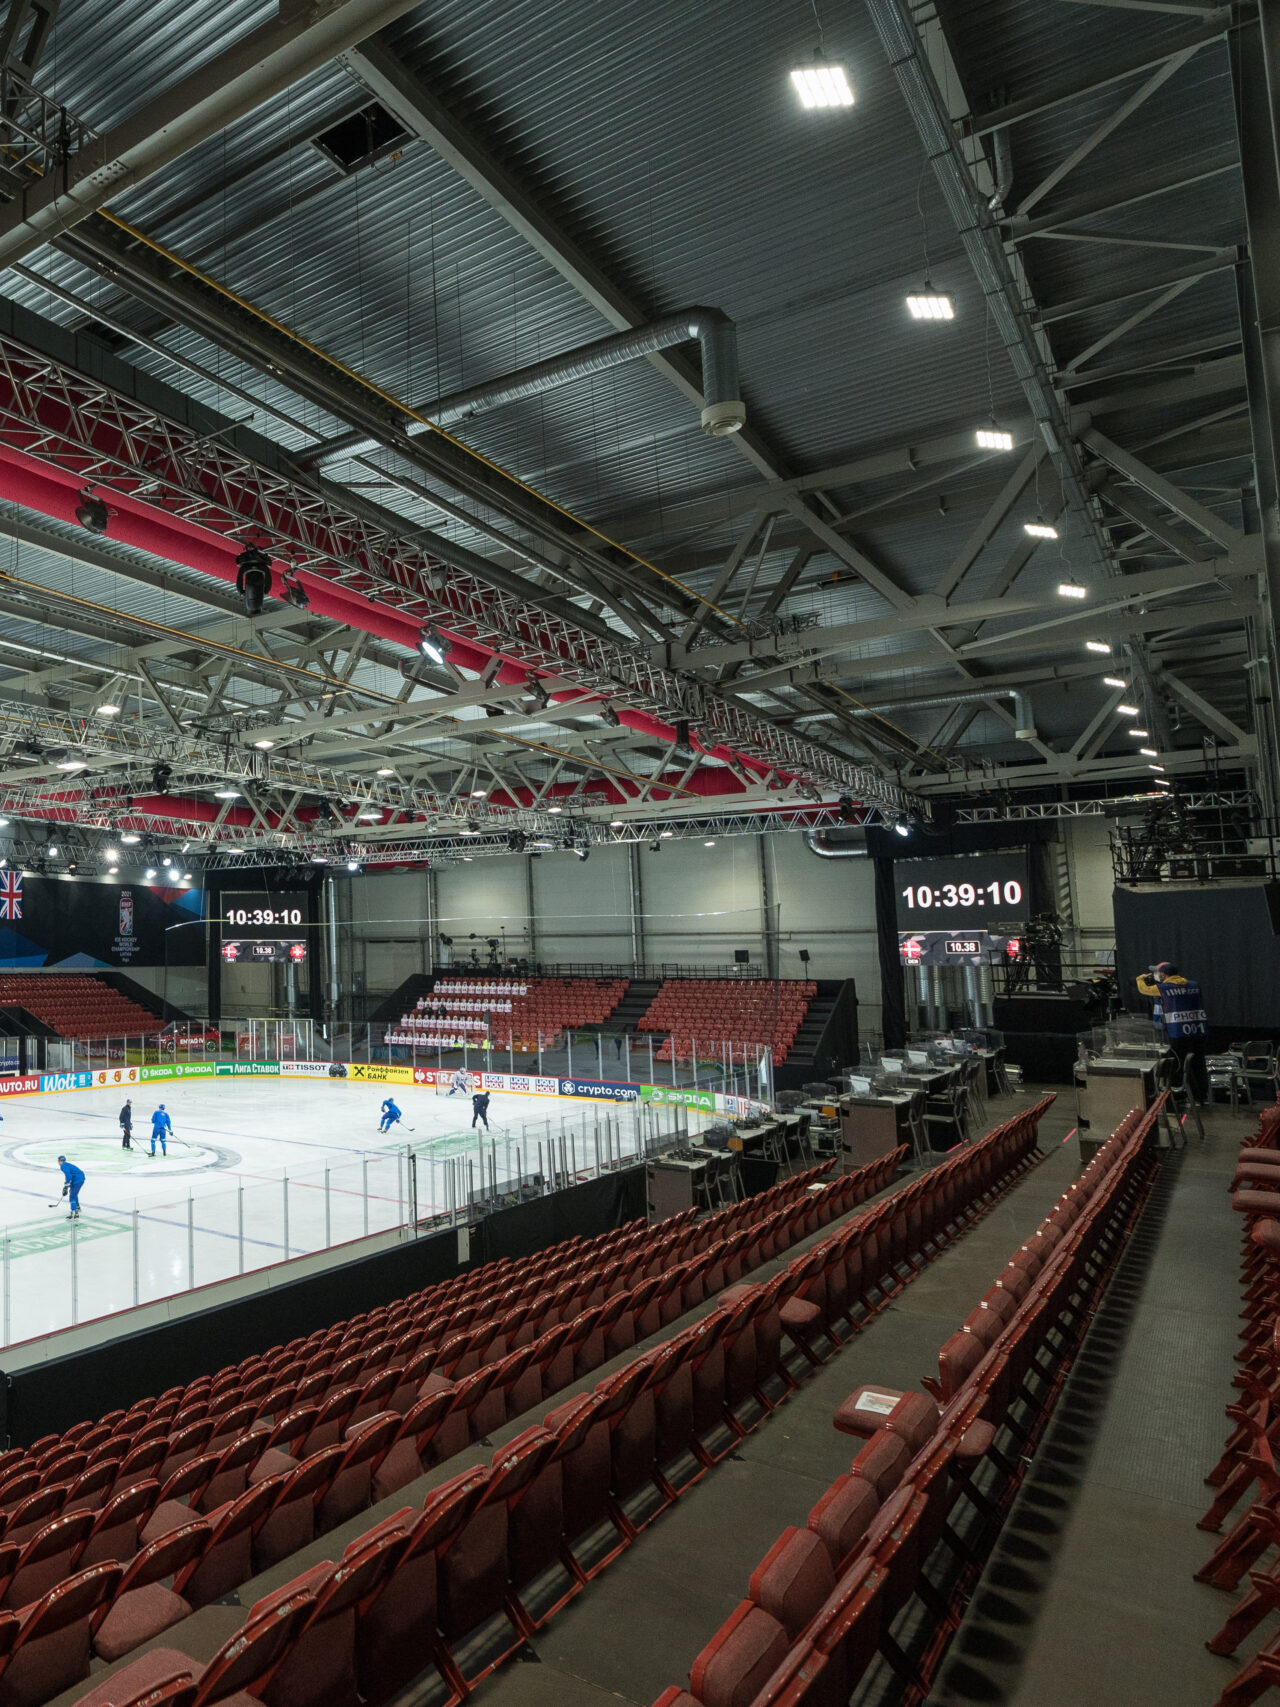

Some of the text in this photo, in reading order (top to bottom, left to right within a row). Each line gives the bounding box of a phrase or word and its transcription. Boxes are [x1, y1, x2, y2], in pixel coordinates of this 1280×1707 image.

[902, 880, 1022, 909] 10:39:10
[226, 909, 302, 925] 10:39:10
[950, 943, 976, 952] 10.38
[1173, 1011, 1207, 1021] PHOTO
[1182, 1022, 1205, 1035] 001
[150, 1068, 173, 1077] ŠKODA
[185, 1065, 213, 1074] ŠKODA
[44, 1073, 77, 1092] Wolt
[485, 1075, 504, 1083] LIQUI
[510, 1077, 529, 1085] LIQUI
[536, 1085, 556, 1093] MOLY
[577, 1084, 637, 1098] crypto.com
